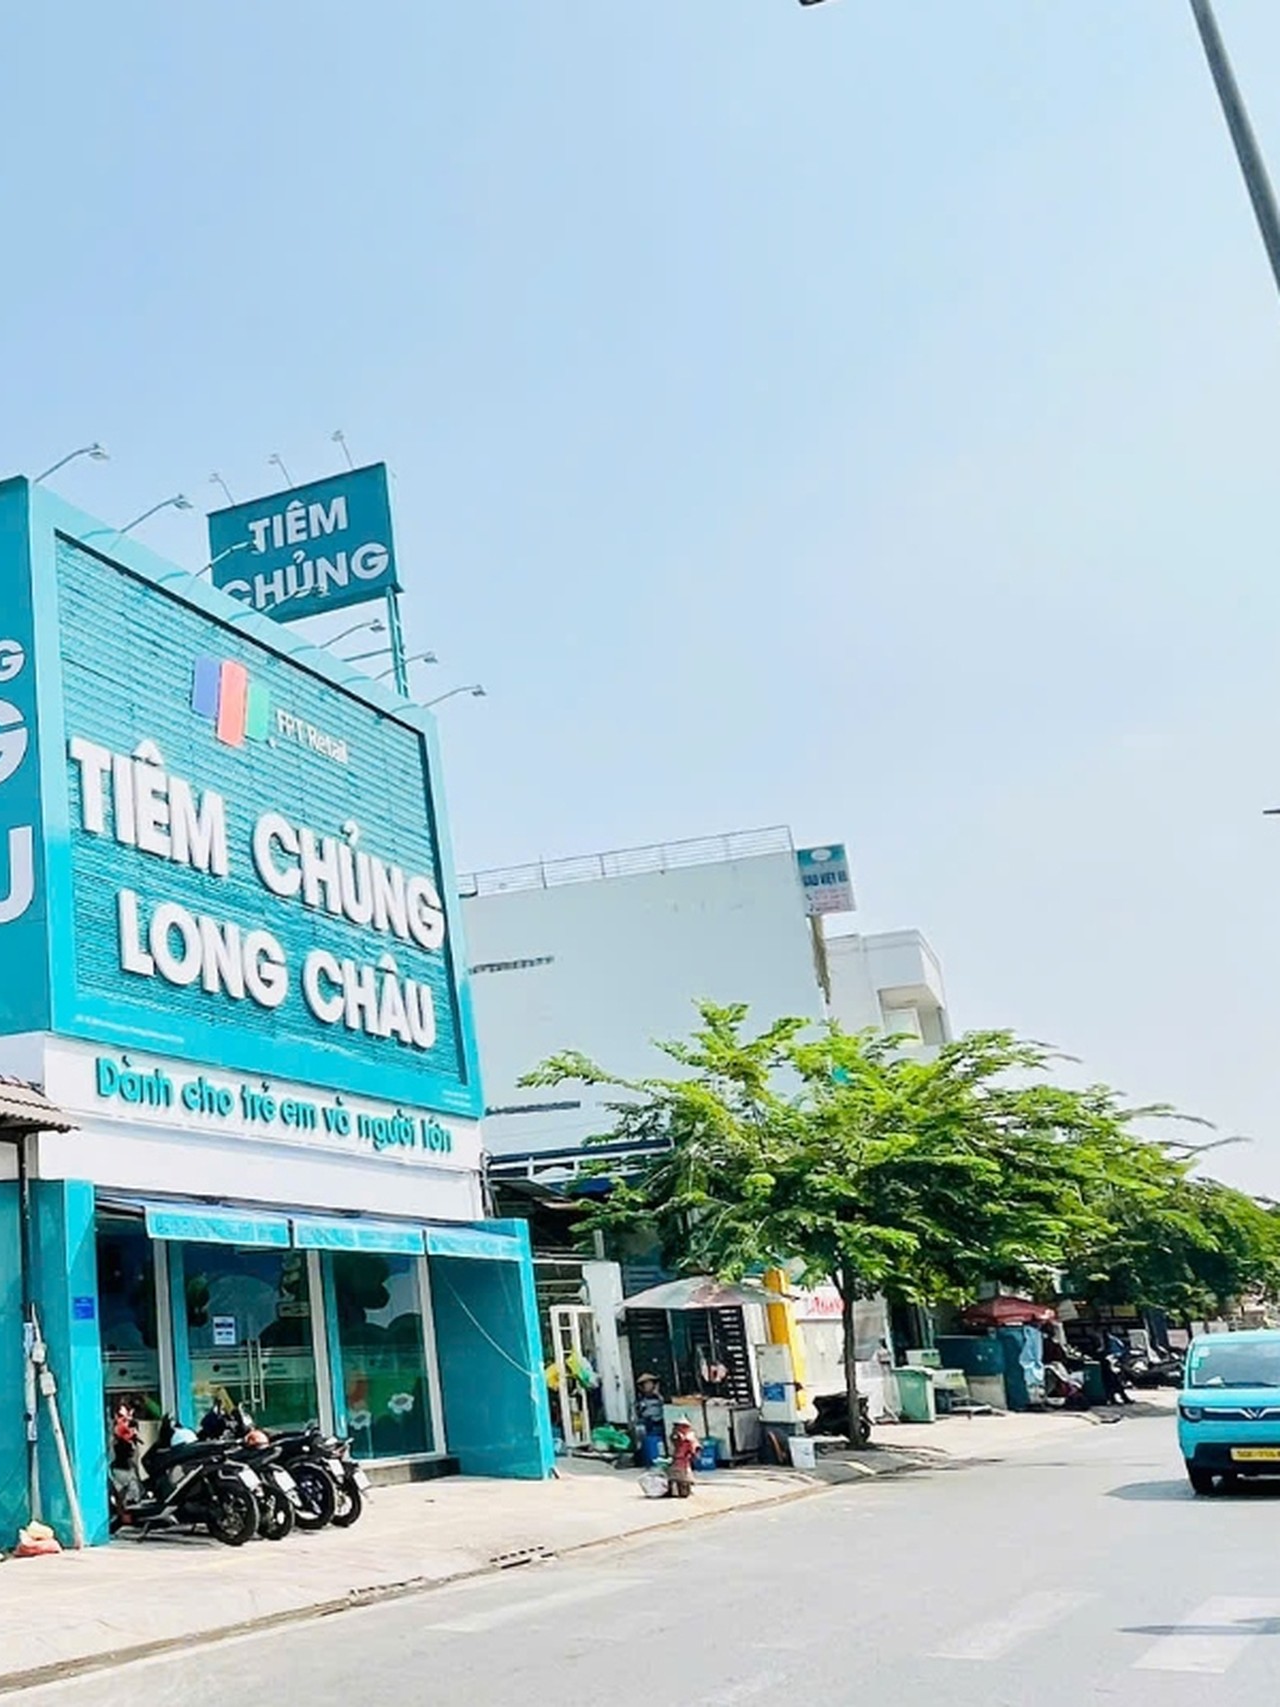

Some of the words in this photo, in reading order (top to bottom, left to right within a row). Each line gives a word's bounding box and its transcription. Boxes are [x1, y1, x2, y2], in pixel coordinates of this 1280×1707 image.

[248, 496, 349, 553] TIÊM
[221, 542, 390, 609] CHỦNG
[276, 708, 304, 742] FPT
[306, 724, 348, 764] Retail
[69, 736, 230, 877] TIÊM
[251, 812, 446, 952] CHỦNG
[117, 888, 289, 1008] LONG
[302, 950, 437, 1050] CHÂU
[96, 1055, 174, 1107] Dành
[181, 1076, 235, 1117] cho
[240, 1081, 277, 1124] trẻ
[280, 1099, 317, 1130] em
[322, 1096, 352, 1136] và
[357, 1107, 416, 1152] người
